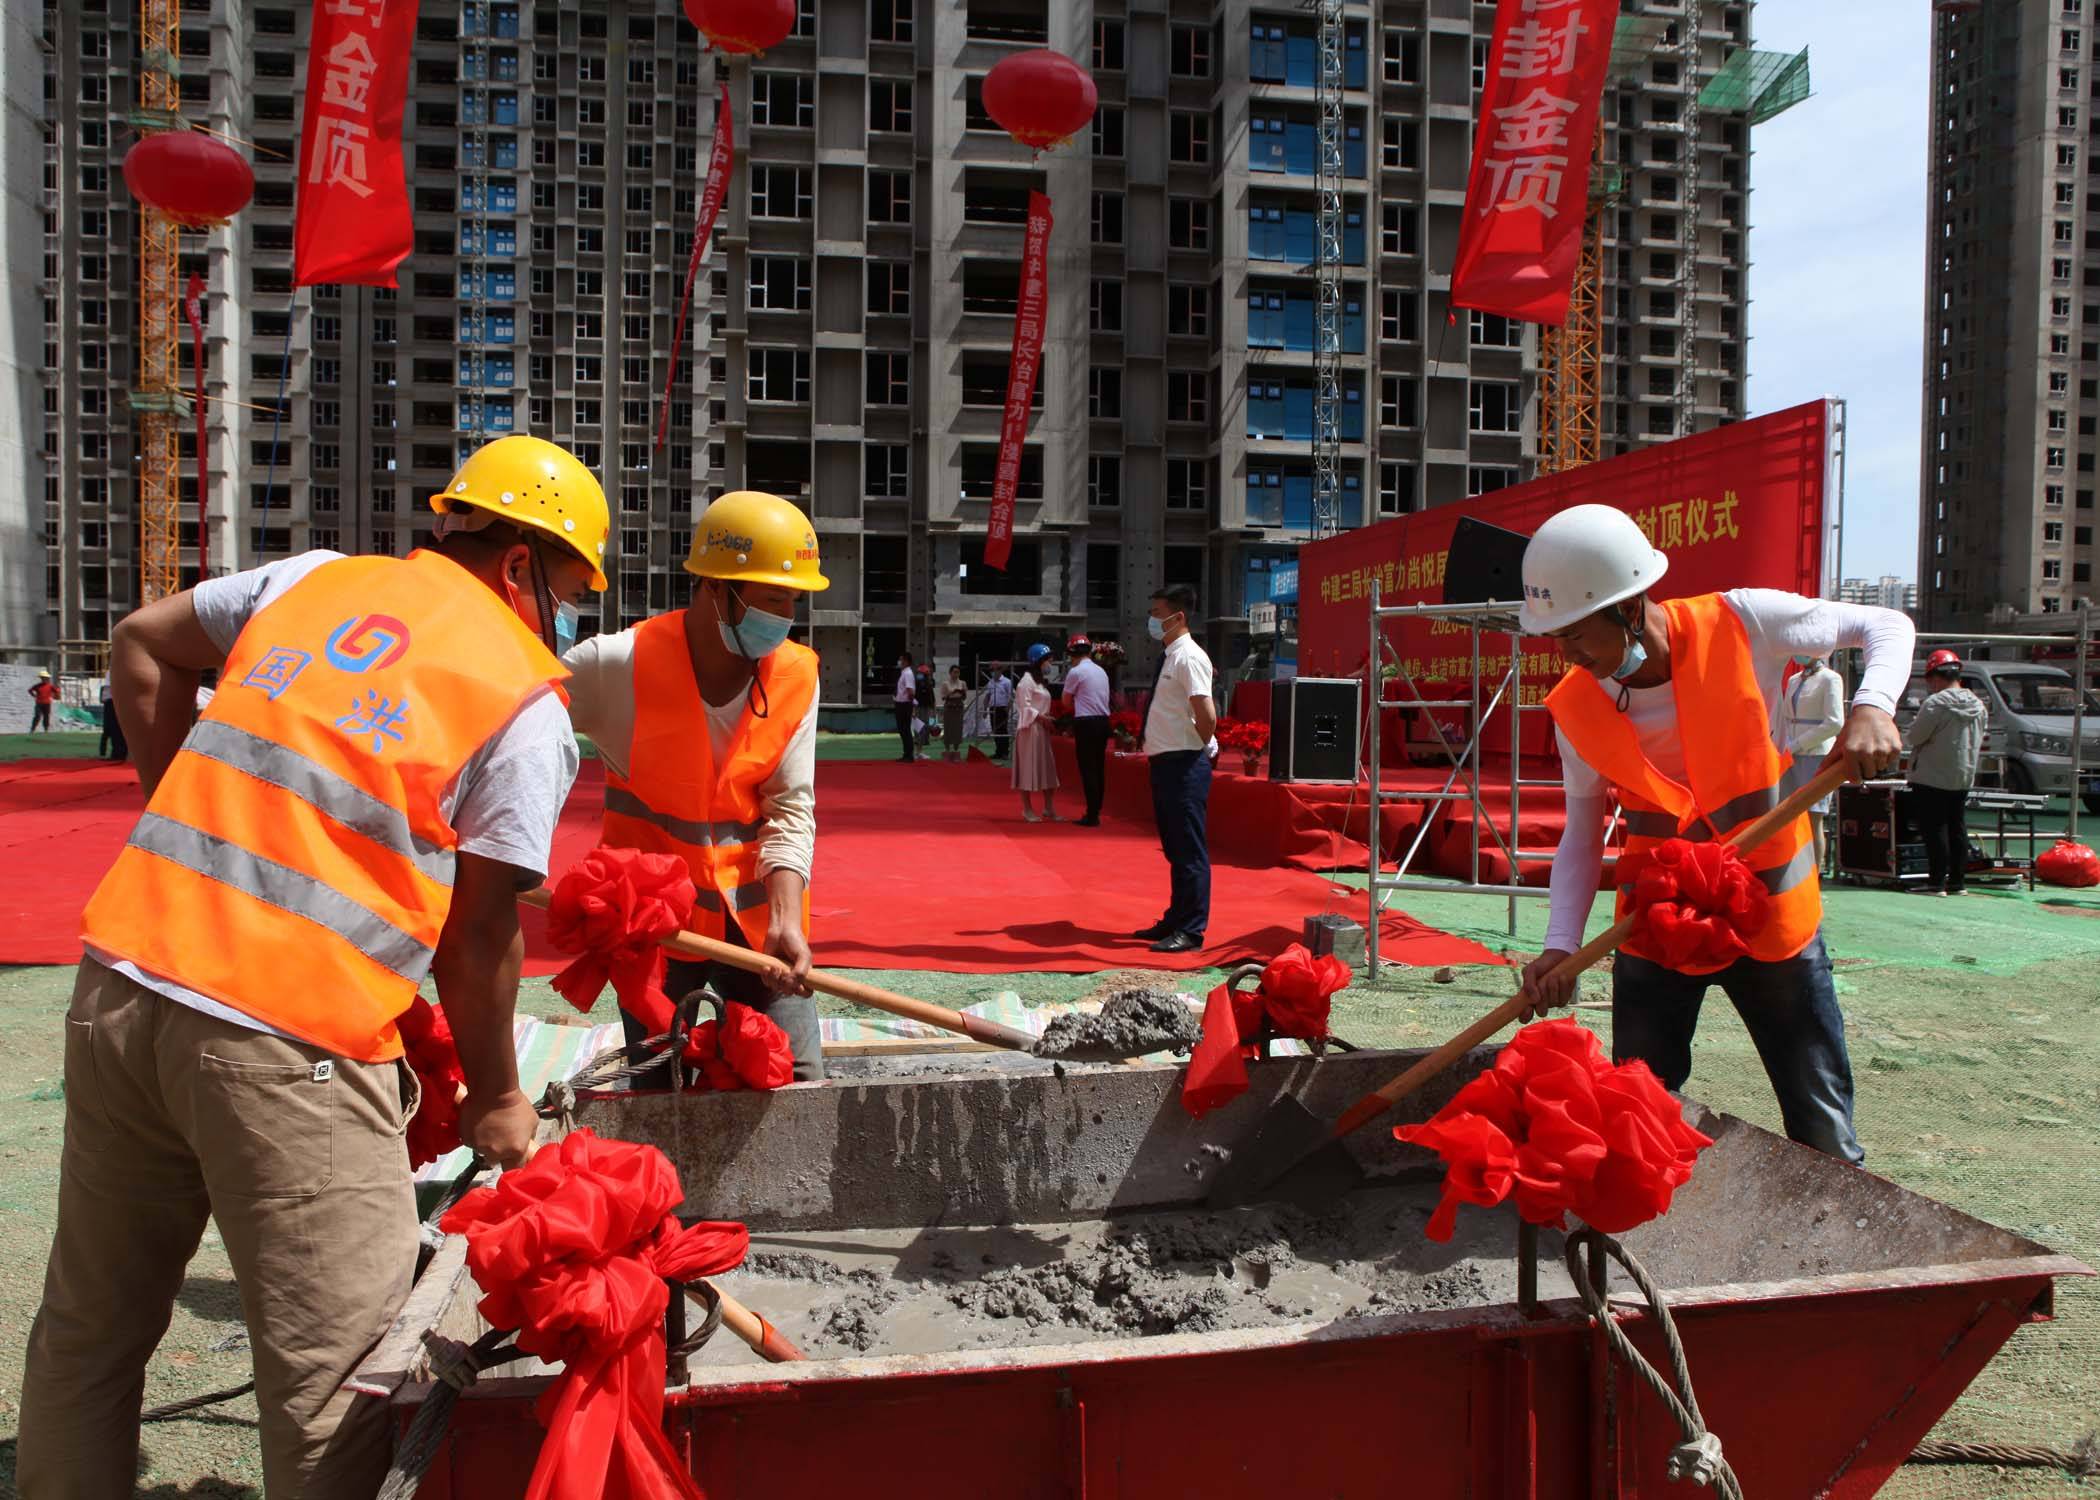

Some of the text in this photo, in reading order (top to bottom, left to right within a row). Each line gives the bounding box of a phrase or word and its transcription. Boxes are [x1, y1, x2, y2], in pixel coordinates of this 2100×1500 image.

[1480, 0, 1589, 219] 封金顶
[240, 645, 409, 753] 国 洪
